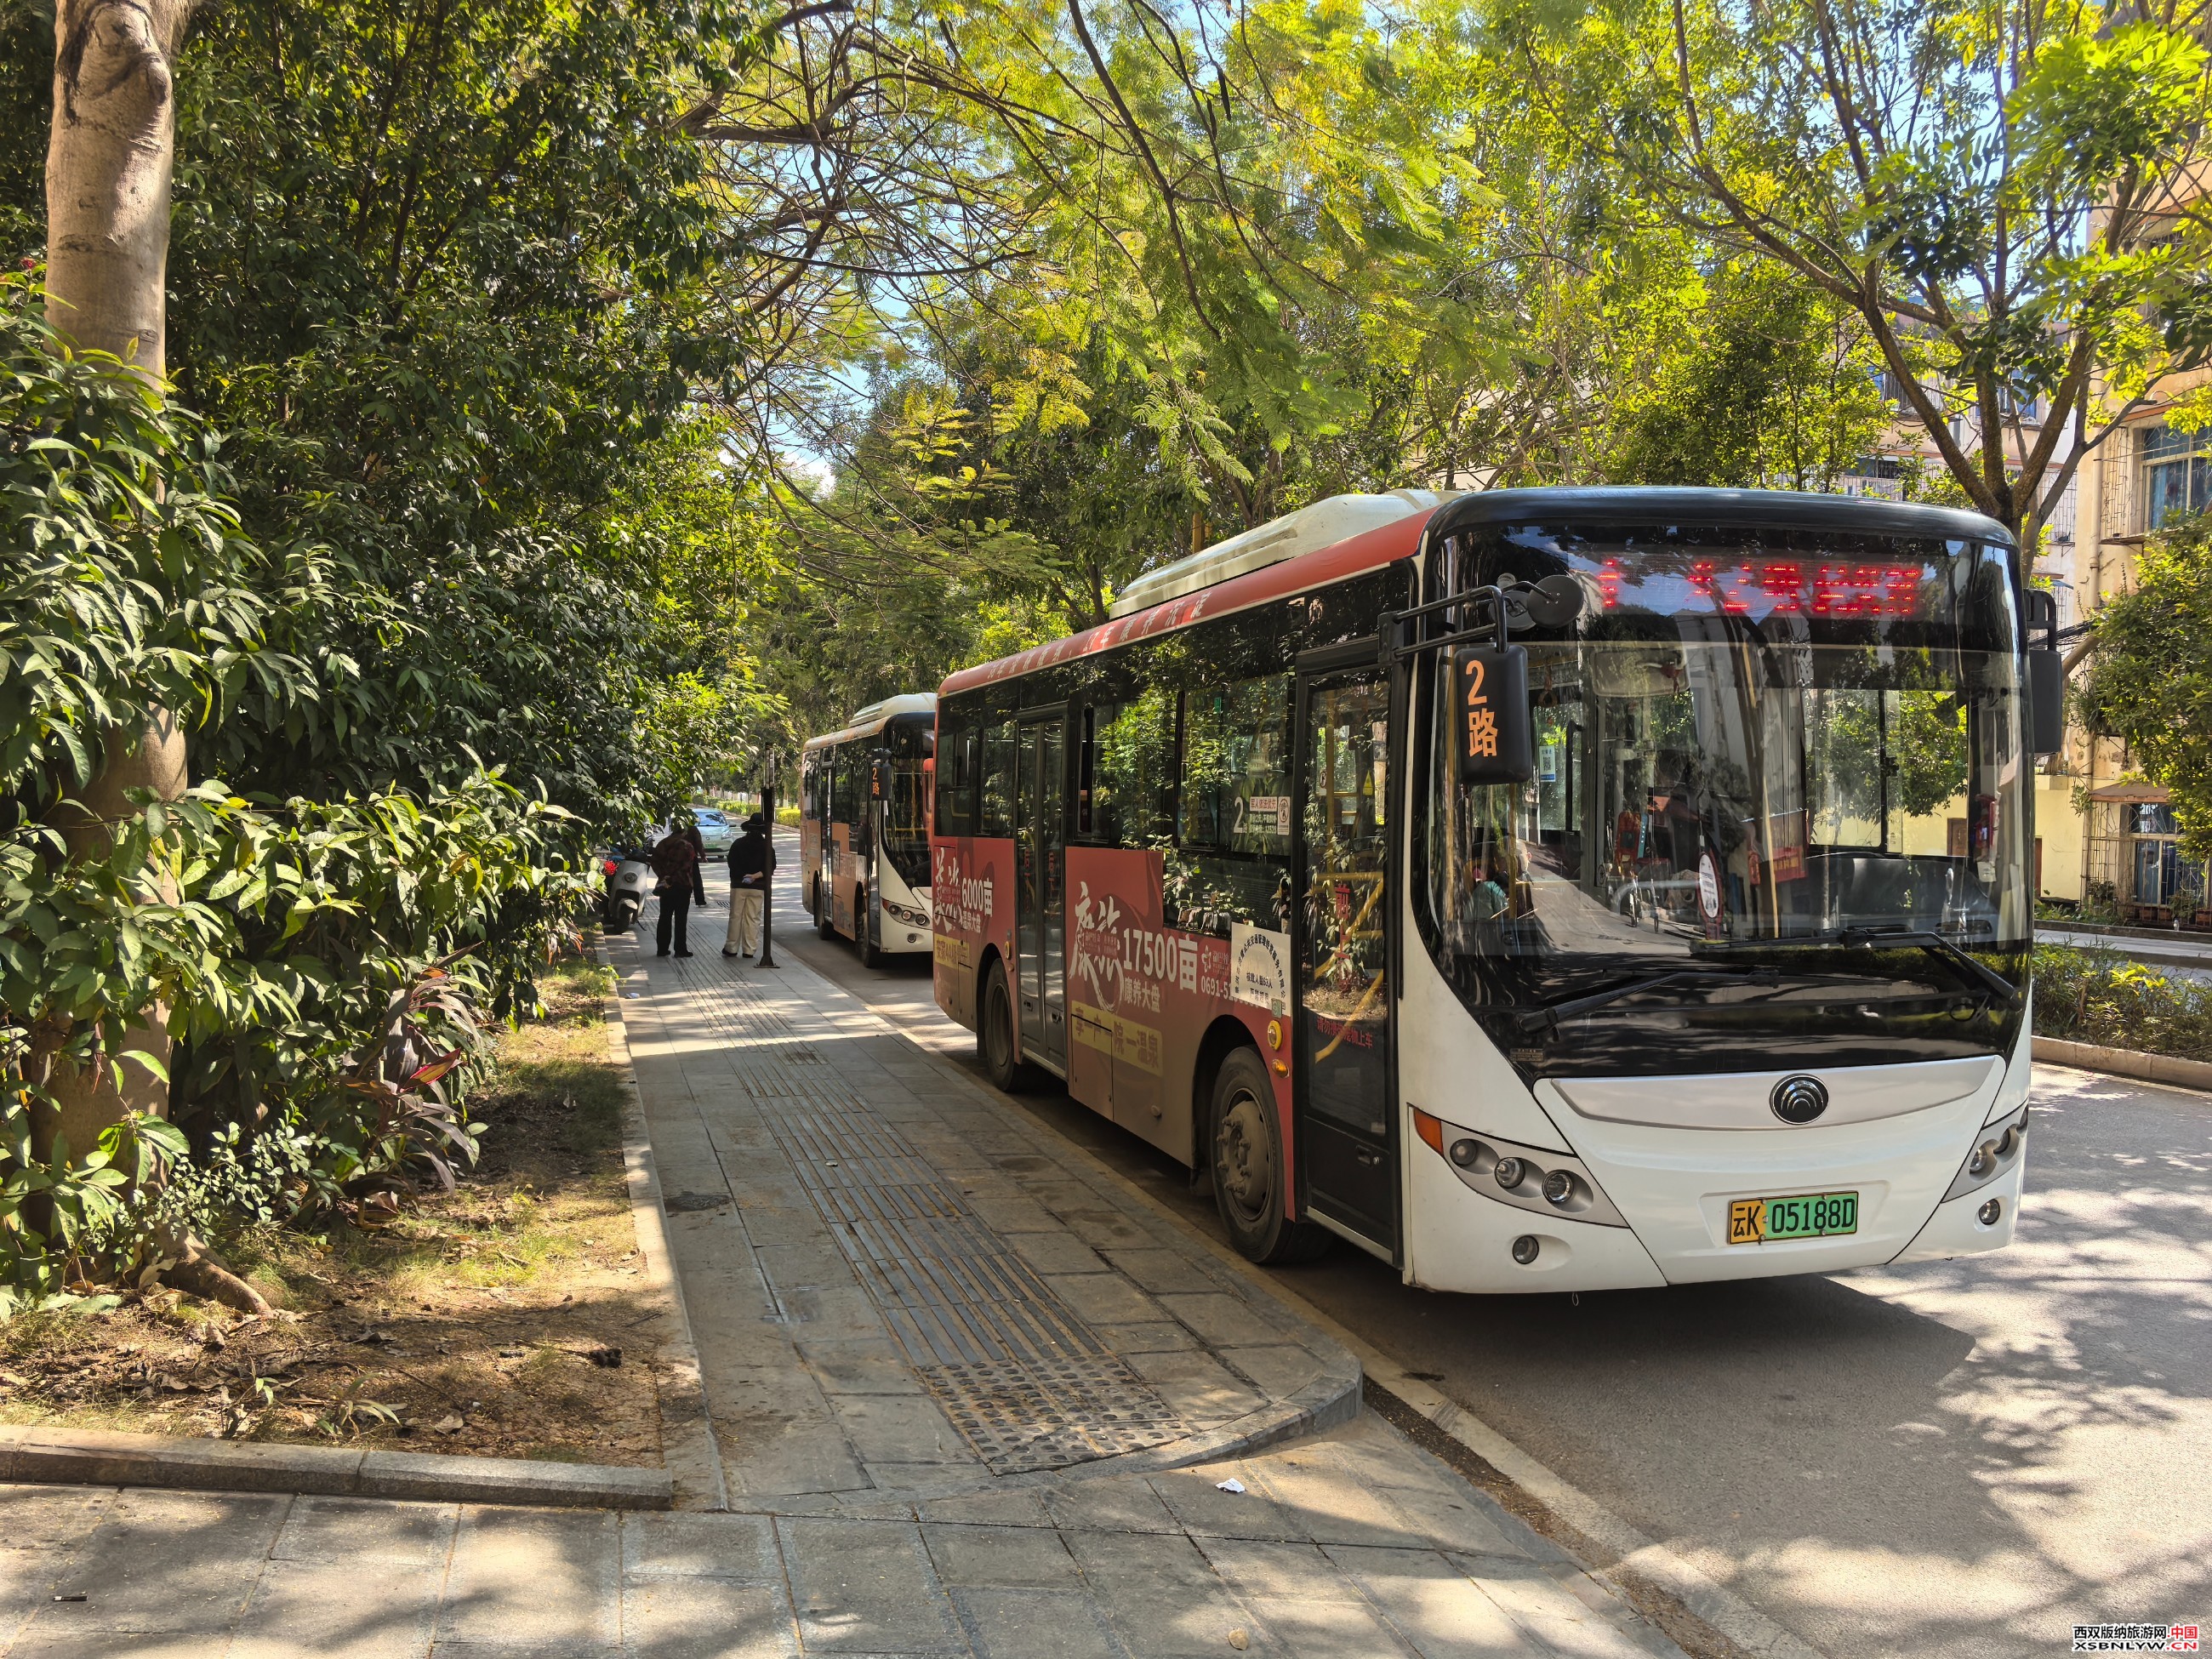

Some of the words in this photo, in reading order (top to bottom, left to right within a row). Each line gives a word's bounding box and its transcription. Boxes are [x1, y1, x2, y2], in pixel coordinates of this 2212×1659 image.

[1465, 659, 1498, 757] 2路
[871, 767, 880, 796] 2路
[961, 876, 993, 917] 6000亩
[1123, 928, 1198, 995] 17500亩
[1124, 977, 1160, 1013] 康养大盘
